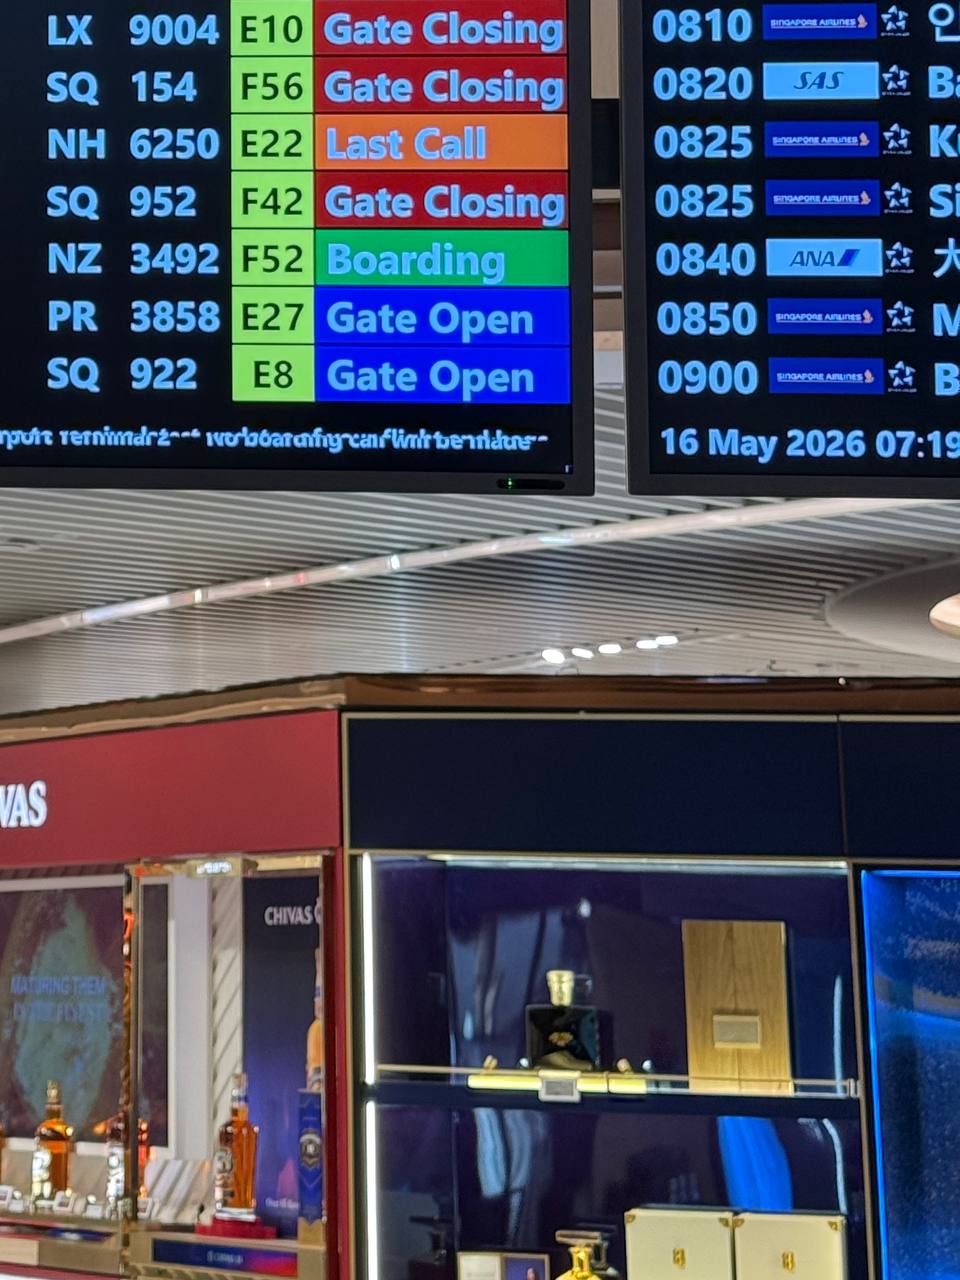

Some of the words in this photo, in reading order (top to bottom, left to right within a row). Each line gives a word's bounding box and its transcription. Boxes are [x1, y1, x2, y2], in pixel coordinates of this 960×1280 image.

[48, 15, 93, 45] LX
[130, 14, 219, 45] 9004
[242, 16, 302, 42] E10
[324, 13, 412, 44] Gate
[423, 12, 563, 51] Closing
[653, 8, 752, 42] 0810
[47, 72, 99, 105] SQ
[132, 71, 197, 102] 154
[243, 73, 302, 100] F56
[324, 71, 412, 102] Gate
[423, 69, 563, 109] Closing
[654, 67, 753, 100] 0820
[793, 72, 844, 89] SAS
[928, 66, 960, 98] B
[48, 129, 105, 159] NH
[130, 128, 219, 159] 6250
[242, 130, 301, 157] E22
[326, 127, 402, 159] Last
[414, 126, 486, 159] Call
[654, 125, 752, 158] 0825
[47, 186, 99, 220] SQ
[130, 186, 196, 217] 952
[243, 188, 302, 214] F42
[324, 186, 412, 216] Gate
[424, 185, 564, 225] Closing
[655, 184, 753, 217] 0825
[49, 243, 102, 273] NZ
[131, 243, 219, 274] 3492
[243, 245, 302, 272] F52
[327, 244, 504, 284] Boarding
[656, 243, 756, 276] 0840
[791, 251, 835, 266] ANA
[49, 301, 98, 331] PR
[131, 301, 220, 332] 3858
[243, 303, 303, 330] E27
[327, 303, 416, 334] Gate
[429, 303, 533, 341] Open
[657, 302, 757, 335] 0850
[47, 357, 100, 392] SQ
[131, 358, 197, 389] 922
[255, 361, 292, 388] E8
[327, 362, 416, 391] Gate
[429, 362, 534, 399] Open
[658, 360, 758, 394] 0900
[661, 428, 699, 455] 16
[709, 429, 778, 463] May
[786, 429, 865, 457] 2026
[876, 431, 960, 458] 07:19
[264, 906, 314, 926] CHIVAS
